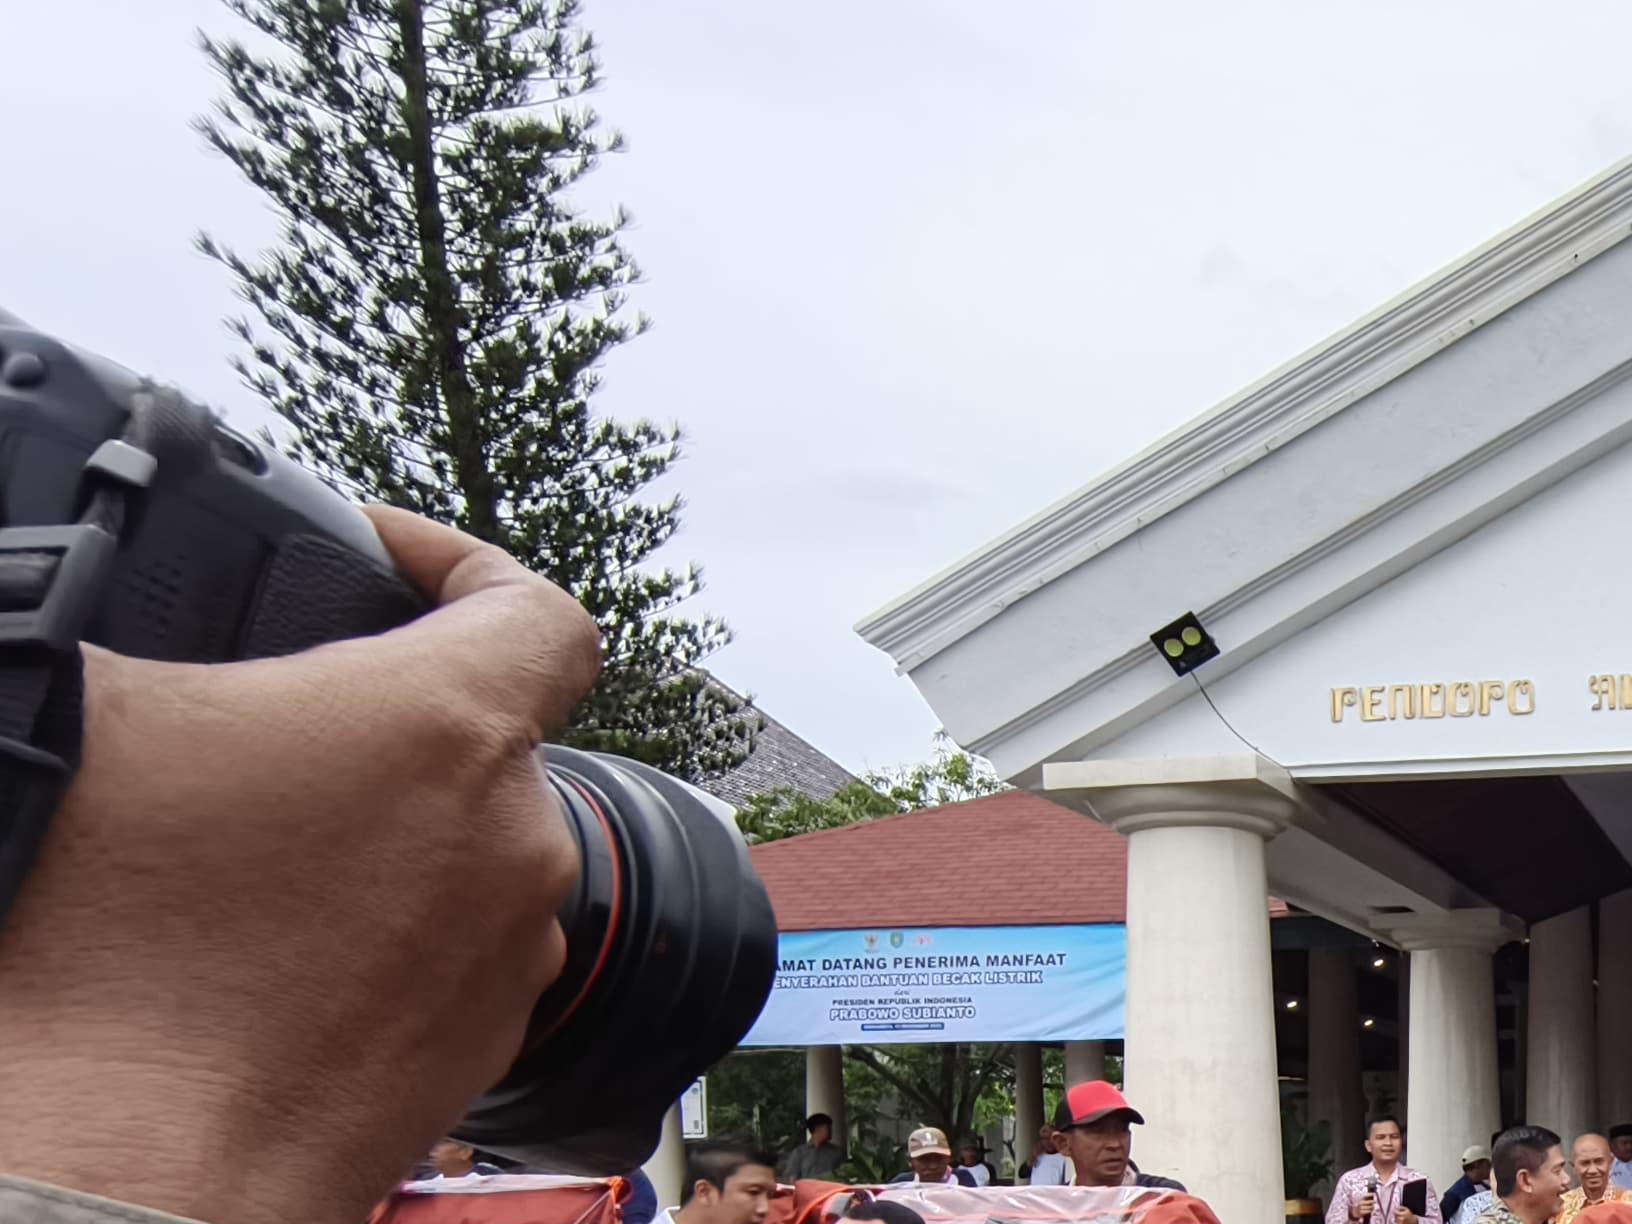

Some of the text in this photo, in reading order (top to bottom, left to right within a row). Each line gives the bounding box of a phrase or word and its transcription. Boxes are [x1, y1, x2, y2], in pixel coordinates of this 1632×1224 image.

[1328, 679, 1536, 723] PENDOPO
[822, 958, 888, 971] DATANG
[893, 955, 981, 970] PENERIMA
[986, 953, 1067, 968] MANFAAT
[861, 973, 929, 987] BANTUAN
[932, 971, 982, 985] BECAK
[984, 970, 1043, 984] LISTRIK
[829, 1005, 977, 1021] PRABOWO SUBIANTO
